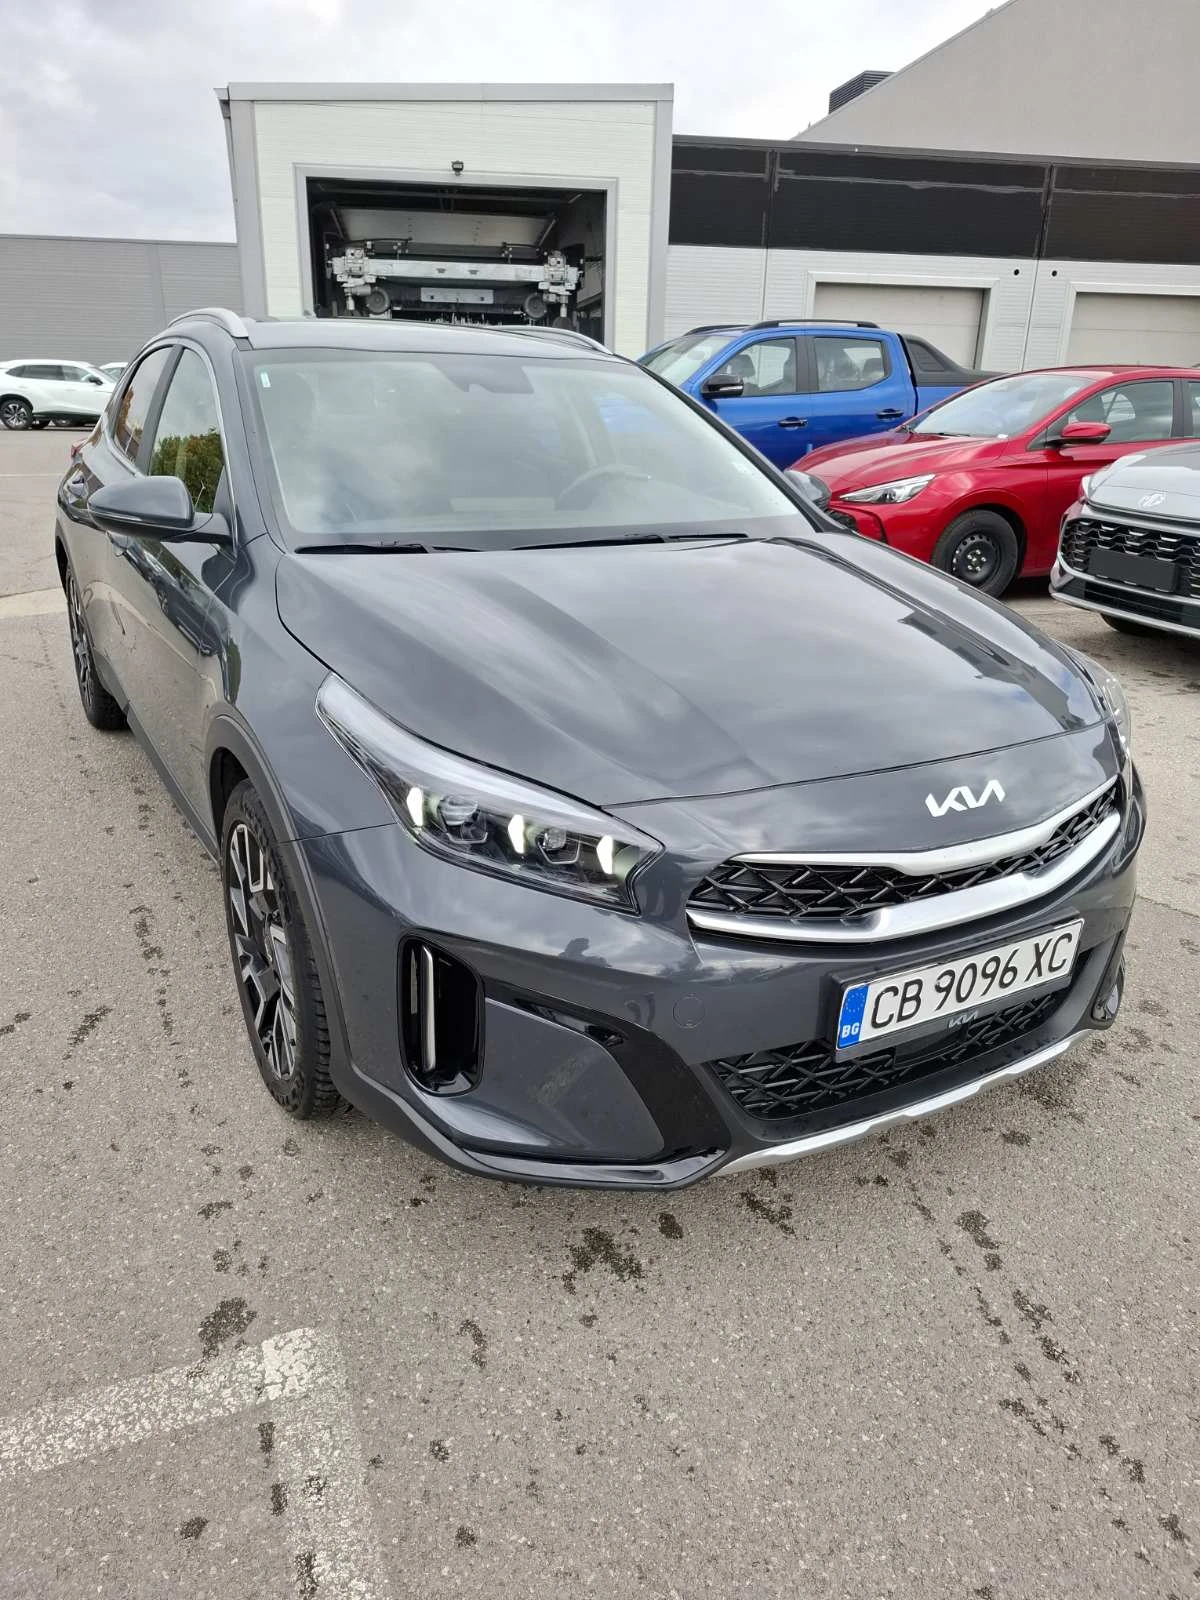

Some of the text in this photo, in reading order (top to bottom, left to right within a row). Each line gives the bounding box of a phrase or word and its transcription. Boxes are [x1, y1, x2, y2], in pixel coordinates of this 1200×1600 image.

[925, 779, 1005, 817] KIA
[871, 932, 1073, 1029] CB 9096 XC
[841, 1022, 860, 1039] BG
